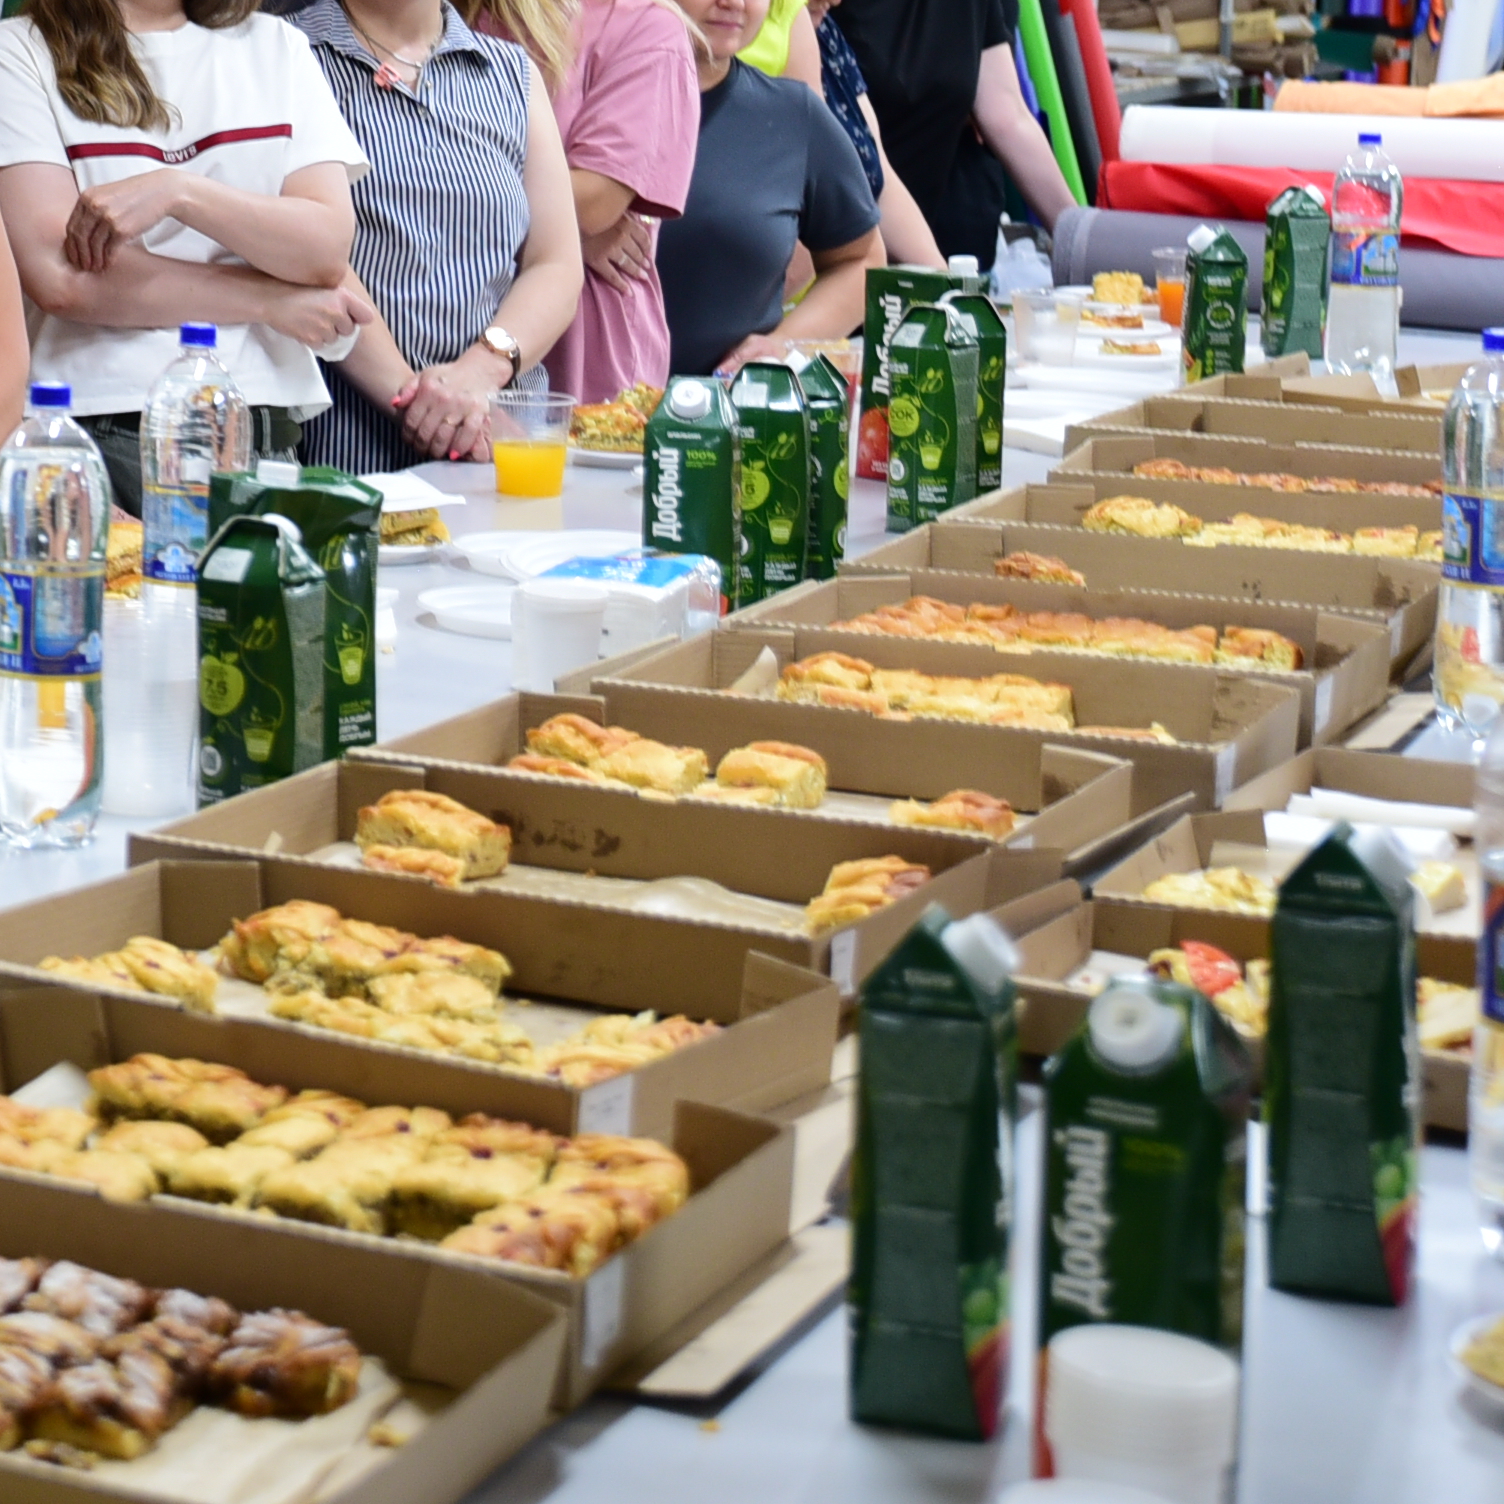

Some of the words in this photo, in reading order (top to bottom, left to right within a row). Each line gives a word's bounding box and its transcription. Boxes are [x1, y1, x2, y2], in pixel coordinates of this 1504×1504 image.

[652, 446, 684, 543] Добрый
[686, 450, 717, 462] 100%
[1052, 1126, 1114, 1318] Добрый
